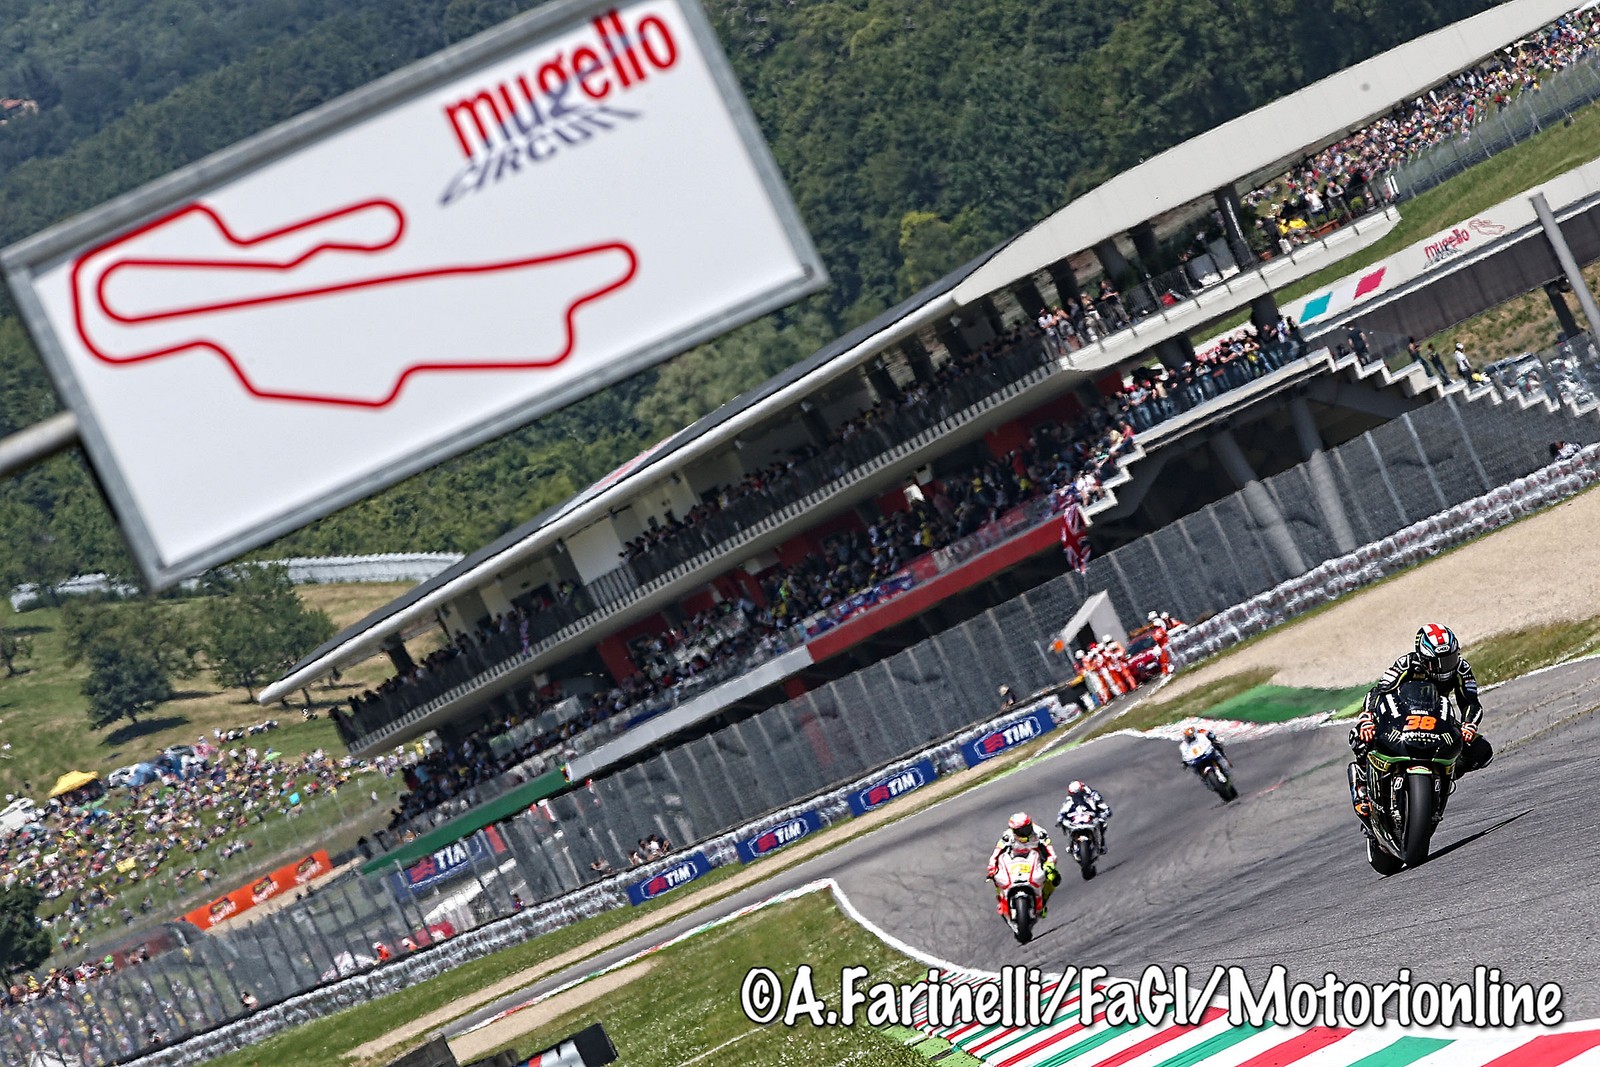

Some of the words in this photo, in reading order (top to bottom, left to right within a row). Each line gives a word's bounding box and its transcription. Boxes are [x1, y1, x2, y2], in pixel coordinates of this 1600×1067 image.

[442, 8, 679, 160] mugello
[1002, 719, 1034, 746] TIM
[1402, 715, 1437, 731] 38
[888, 771, 916, 797] TIM
[775, 822, 802, 844] TIM
[664, 862, 691, 886] TIM
